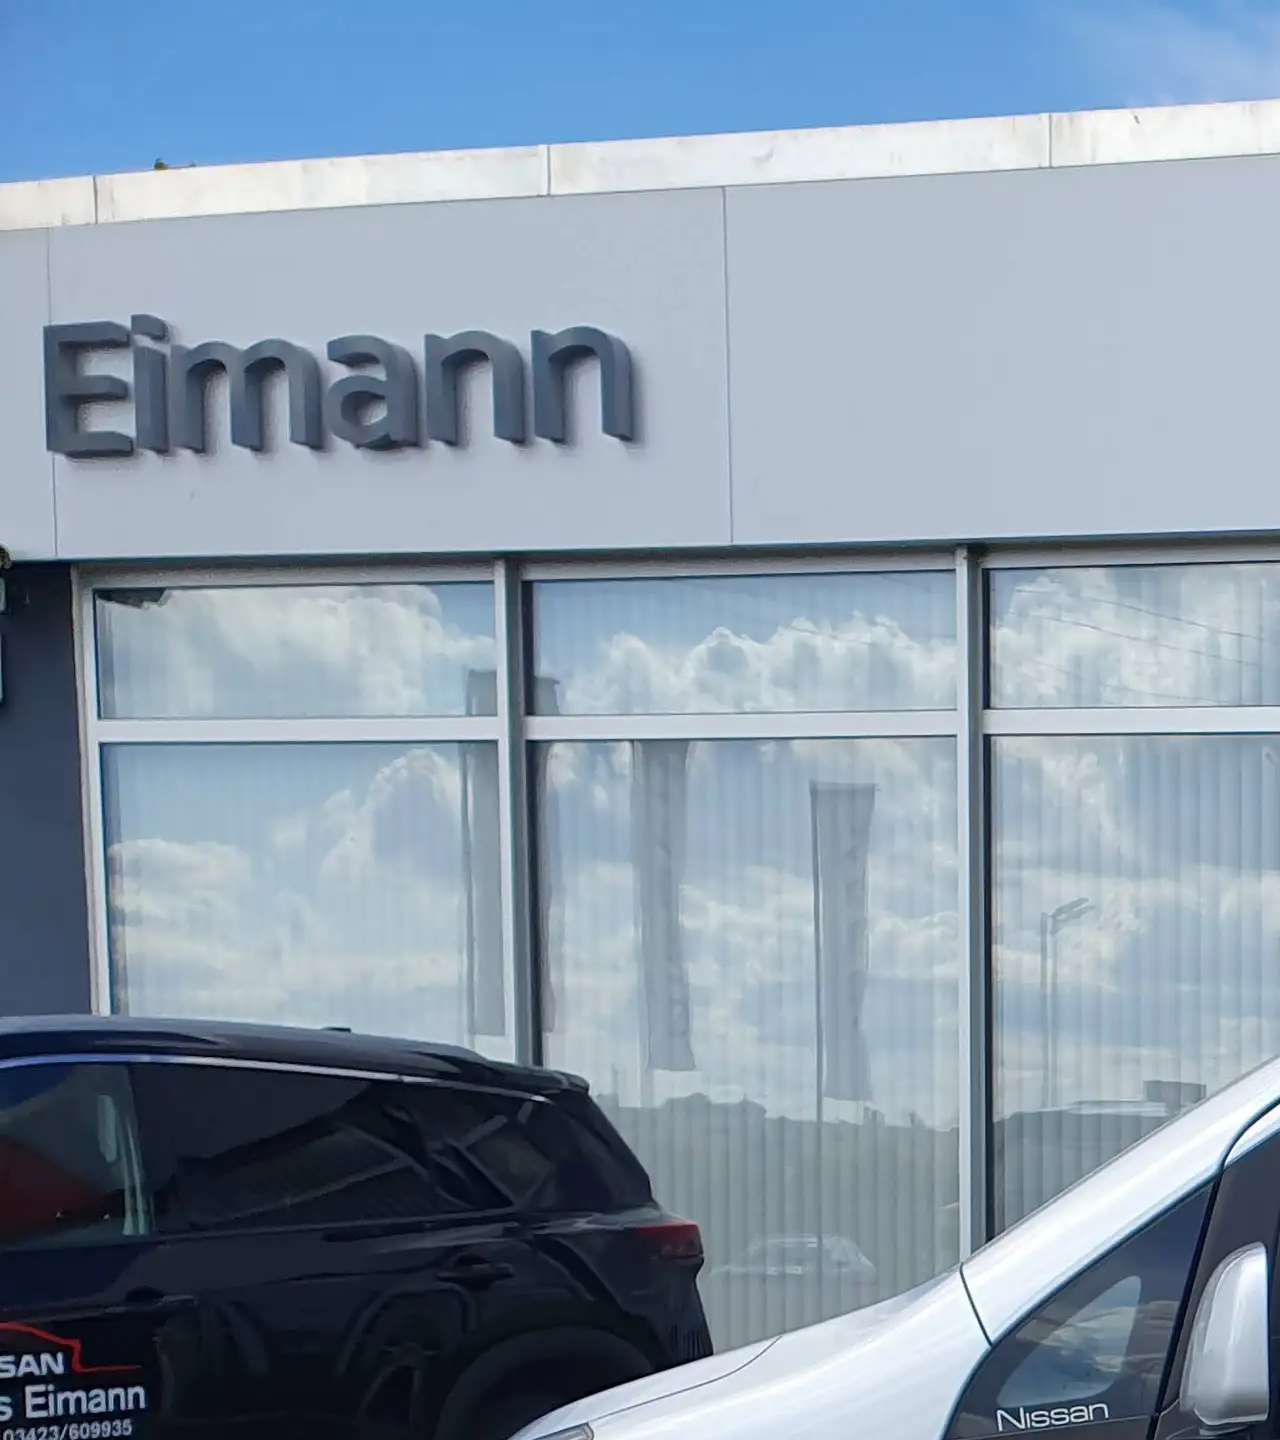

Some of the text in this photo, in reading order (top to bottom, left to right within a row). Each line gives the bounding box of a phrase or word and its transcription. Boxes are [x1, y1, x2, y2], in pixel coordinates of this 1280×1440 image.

[43, 313, 634, 460] Eimann
[25, 1383, 147, 1418] Eimann
[996, 1402, 1109, 1432] Nissan
